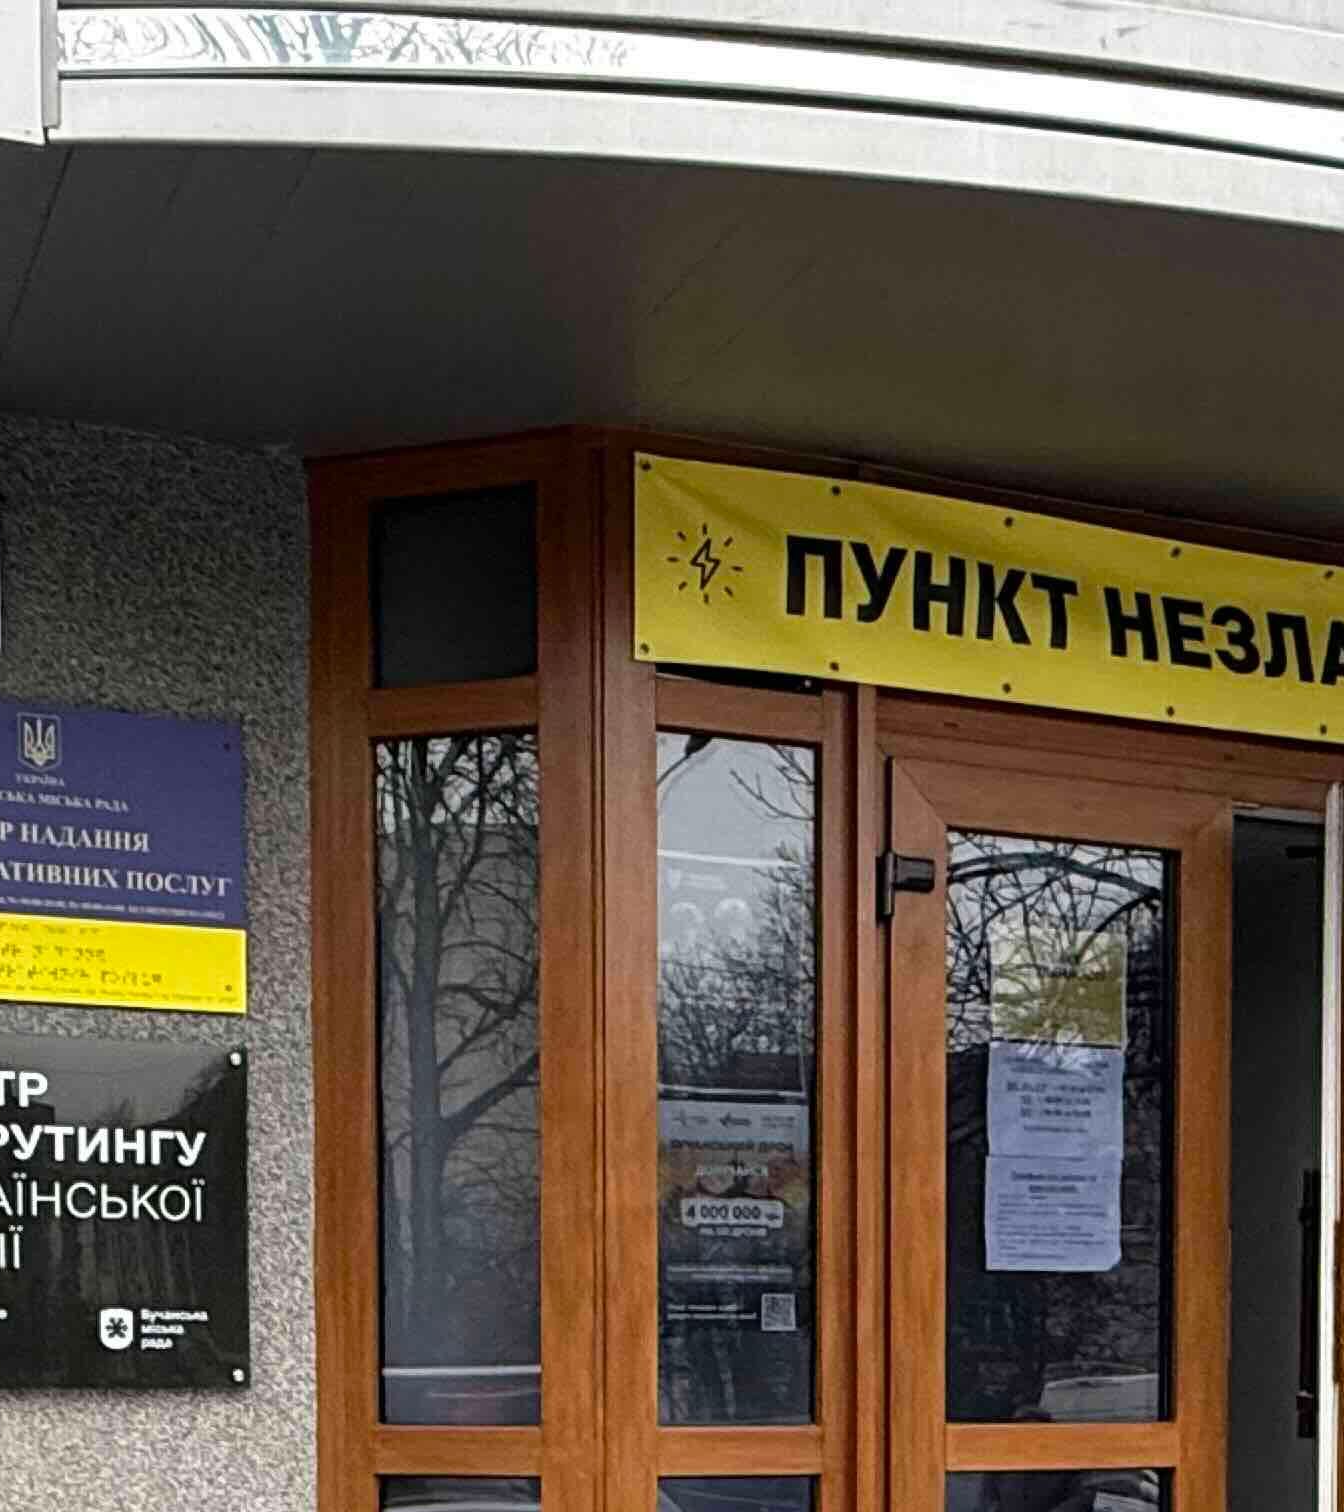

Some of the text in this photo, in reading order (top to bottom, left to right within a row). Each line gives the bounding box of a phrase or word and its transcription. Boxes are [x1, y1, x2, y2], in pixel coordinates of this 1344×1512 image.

[785, 533, 1081, 653] ПУНКТ
[21, 822, 150, 853] НАДАННЯ
[126, 870, 232, 897] ПОСЛУГ
